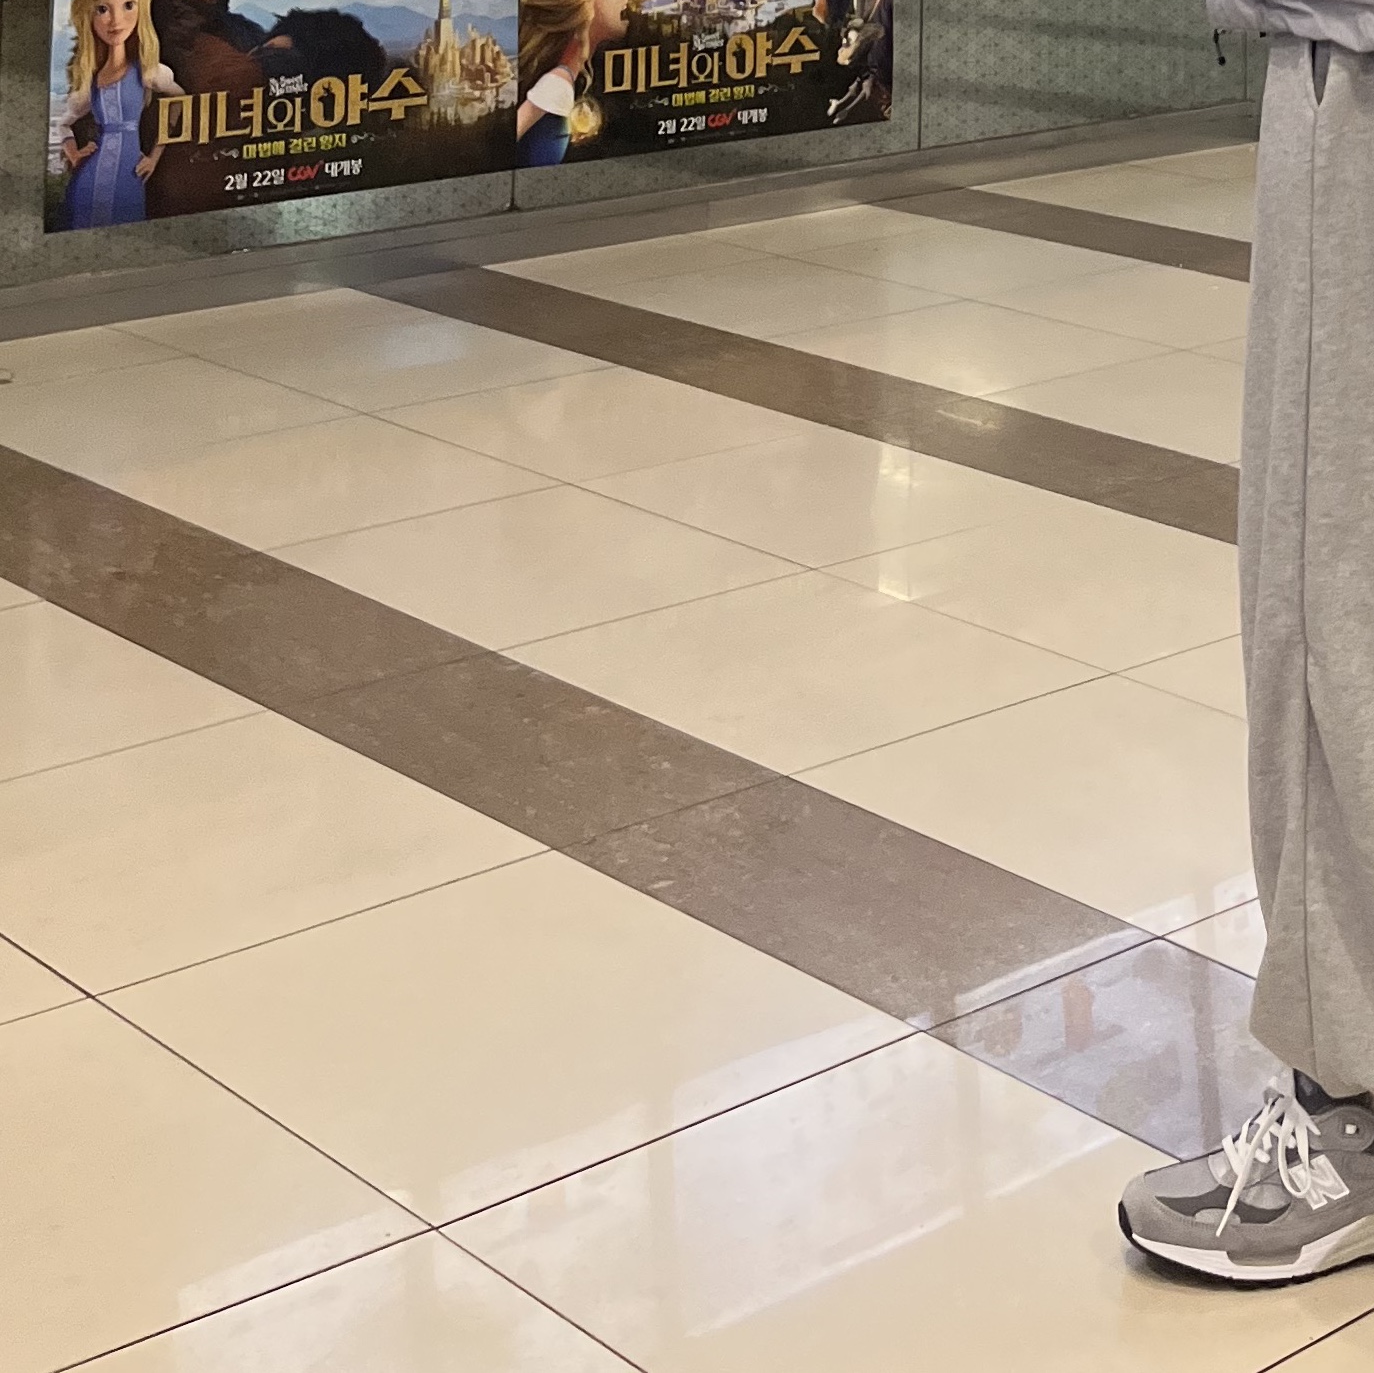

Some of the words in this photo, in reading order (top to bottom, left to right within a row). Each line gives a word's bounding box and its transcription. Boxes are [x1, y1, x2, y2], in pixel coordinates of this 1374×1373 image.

[657, 119, 677, 135] 2월
[680, 115, 706, 132] 22일
[707, 107, 737, 128] CGV
[737, 107, 768, 125] 대개봉
[242, 140, 285, 159] 마법에
[289, 136, 317, 154] 걸린
[224, 172, 248, 191] 2월
[252, 168, 285, 187] 22일
[287, 160, 325, 181] CGV
[324, 158, 363, 178] 대개봉
